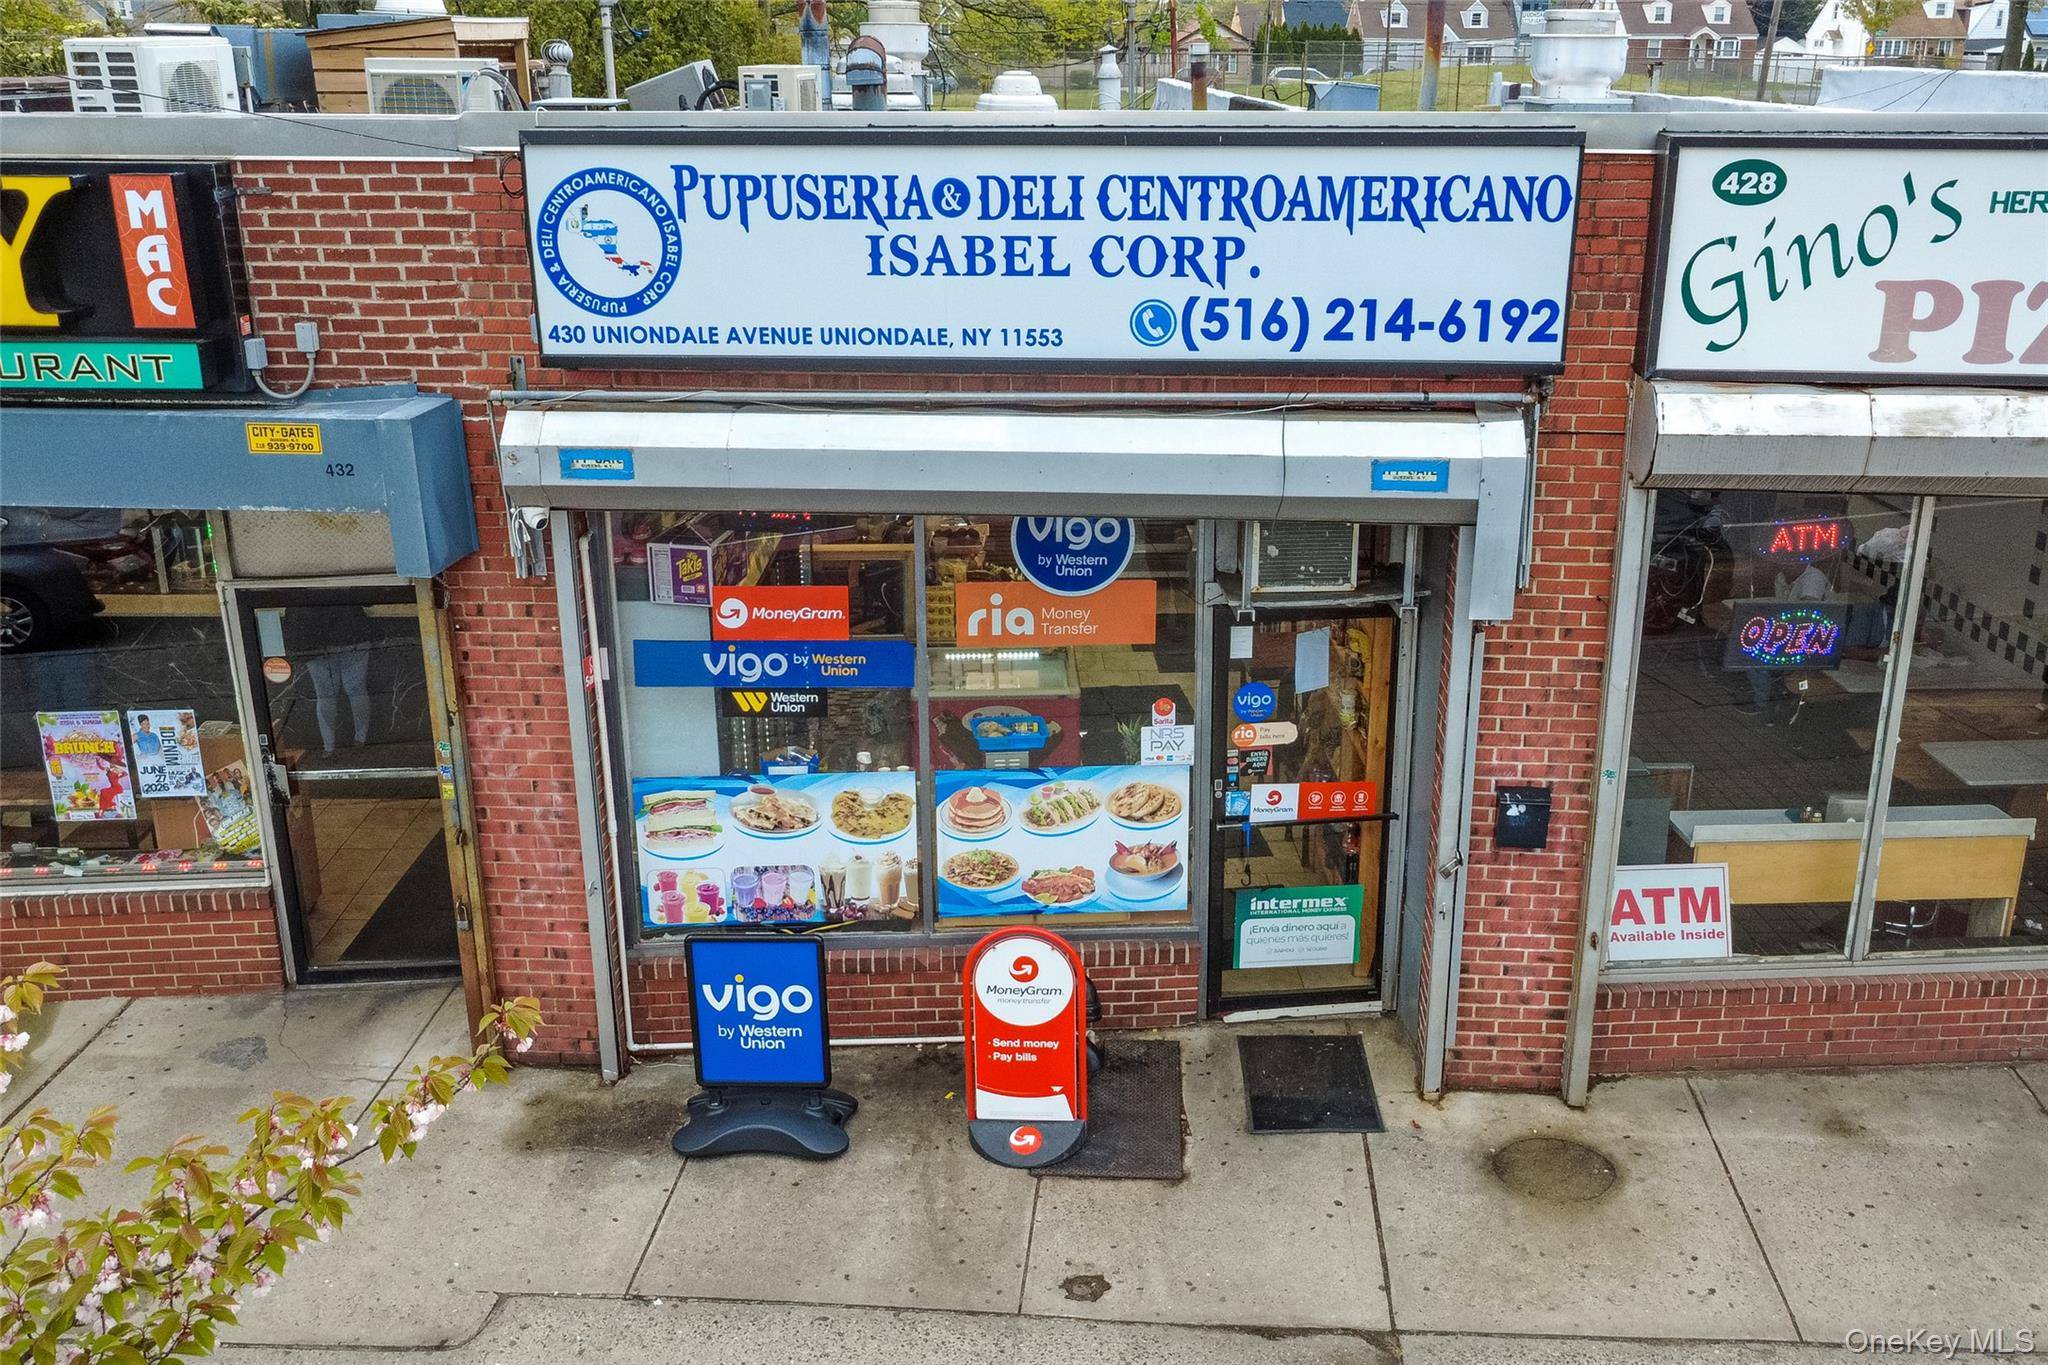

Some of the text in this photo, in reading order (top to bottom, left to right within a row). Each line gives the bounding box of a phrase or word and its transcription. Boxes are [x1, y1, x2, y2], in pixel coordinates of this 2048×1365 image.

[1720, 171, 1777, 195] 428
[670, 164, 1573, 235] PUPUSERIA & DELI CENTROAMERICANO
[1989, 191, 2048, 214] HER
[541, 171, 679, 313] PUPUSERIA & DELI CENTROAMERICANO ISABEL CORP.
[124, 190, 177, 316] MAC
[865, 234, 1260, 290] ISABEL CORP.
[1681, 170, 1963, 353] Gino's
[1181, 296, 1560, 352] (516) 214-6192
[548, 324, 1063, 349] 430 UNIONDALE AVENUE UNIONDALE, NY 11553
[252, 426, 314, 438] CITY-GATES
[325, 463, 355, 477] 432
[1026, 517, 1121, 550] vigo
[1771, 522, 1839, 554] ATM
[1038, 554, 1107, 568] by Western
[1056, 565, 1093, 577] Union
[968, 592, 1035, 636] ria
[1041, 607, 1091, 622] Money
[1041, 622, 1099, 635] Transfer
[1740, 616, 1840, 656] OPEN
[702, 644, 866, 683] vigo by Western
[821, 665, 858, 676] Union
[770, 692, 818, 703] Western
[1237, 692, 1271, 708] vigo
[771, 703, 805, 713] Union
[1151, 727, 1185, 740] NRS
[1234, 727, 1254, 739] ria
[160, 731, 181, 766] DENIM
[1151, 740, 1185, 751] PAY
[140, 766, 167, 775] JUNE
[144, 783, 170, 792] 2026
[1250, 896, 1347, 910] intermex
[1610, 886, 1721, 926] ATM
[1281, 923, 1315, 933] dinero
[1246, 935, 1286, 945] quienes
[1610, 929, 1725, 942] Available Inside
[702, 973, 813, 1021] vigo
[986, 985, 1062, 997] MoneyGram
[718, 1025, 802, 1039] by Western
[740, 1037, 785, 1049] Union
[992, 1038, 1059, 1049] Send money
[992, 1052, 1037, 1062] Pay bills
